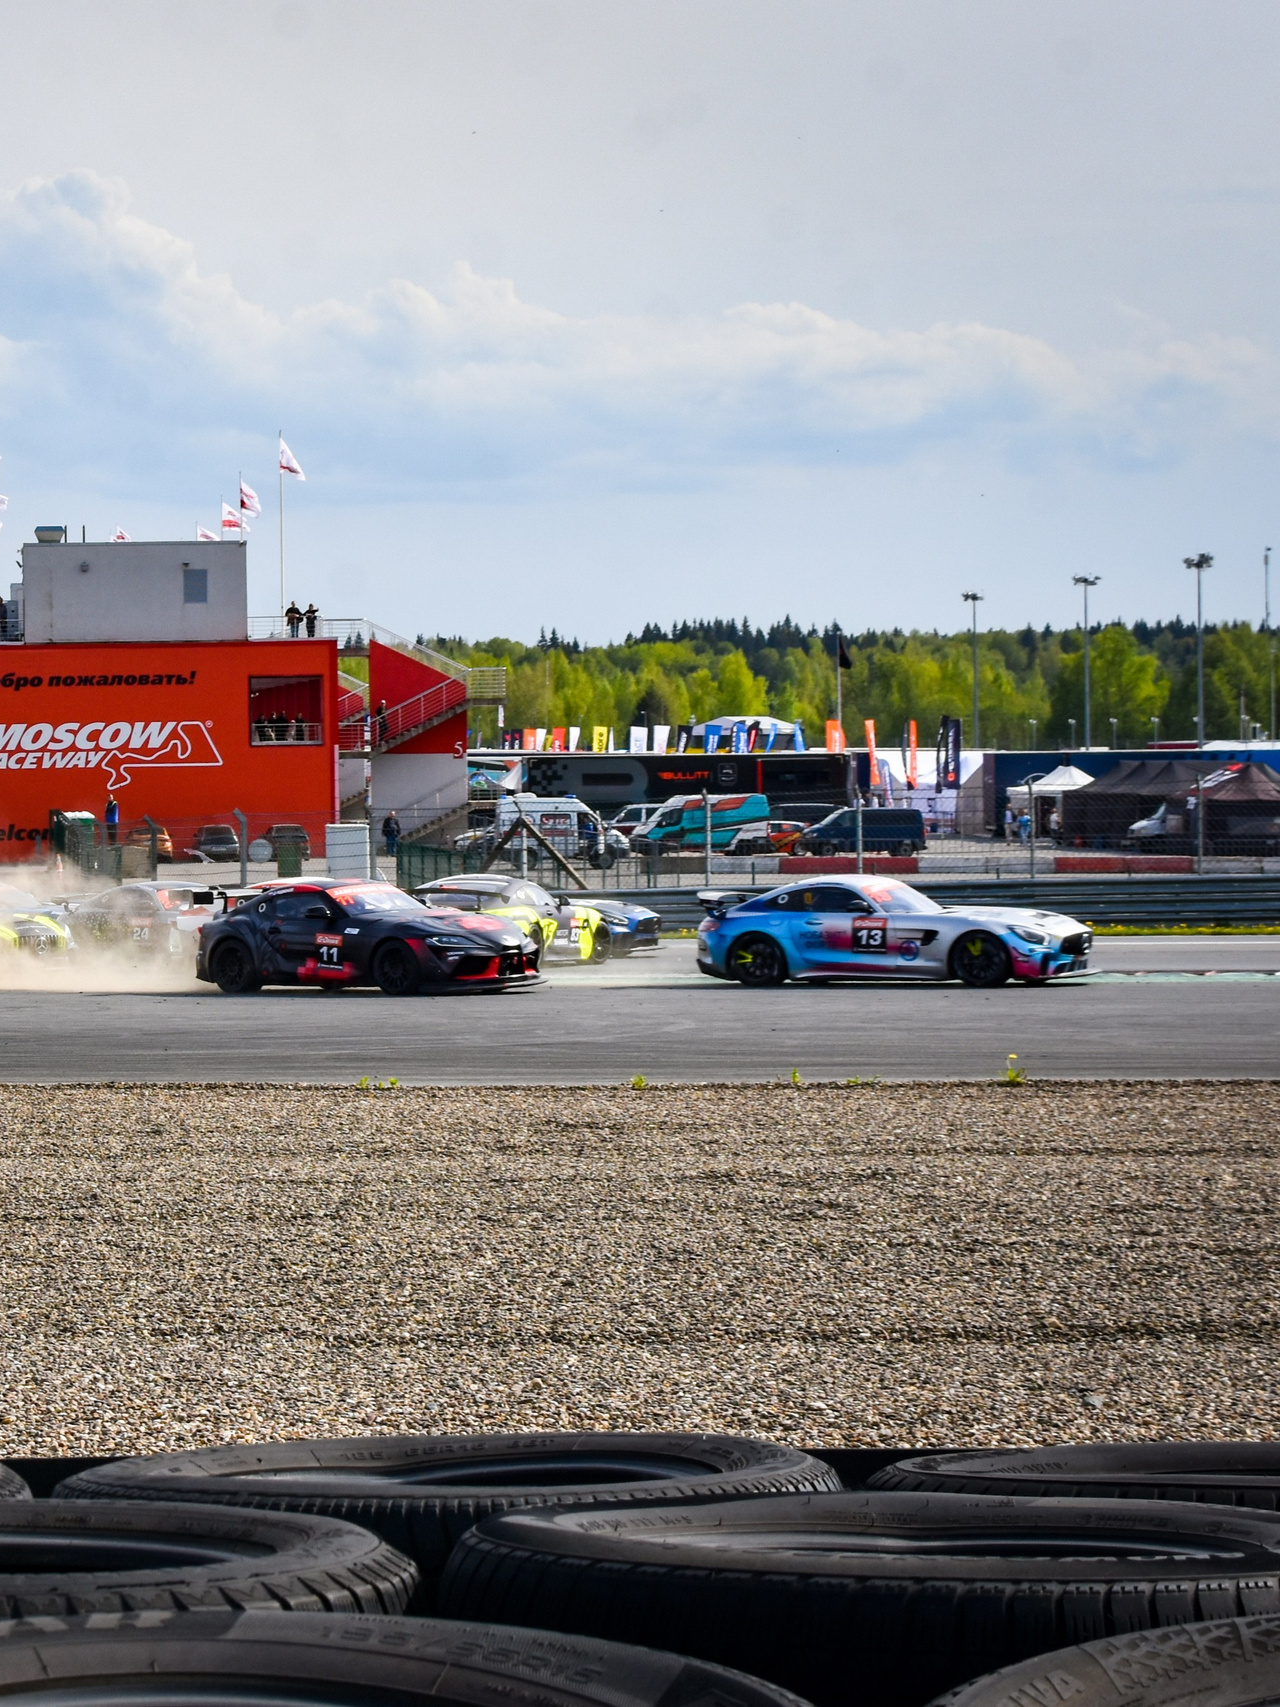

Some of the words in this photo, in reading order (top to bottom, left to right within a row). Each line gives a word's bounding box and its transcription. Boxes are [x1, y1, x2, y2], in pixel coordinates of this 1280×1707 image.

[47, 671, 197, 687] пожаловать!
[453, 742, 463, 758] 5
[133, 927, 149, 940] 24
[858, 929, 883, 945] 13
[319, 946, 339, 962] 11
